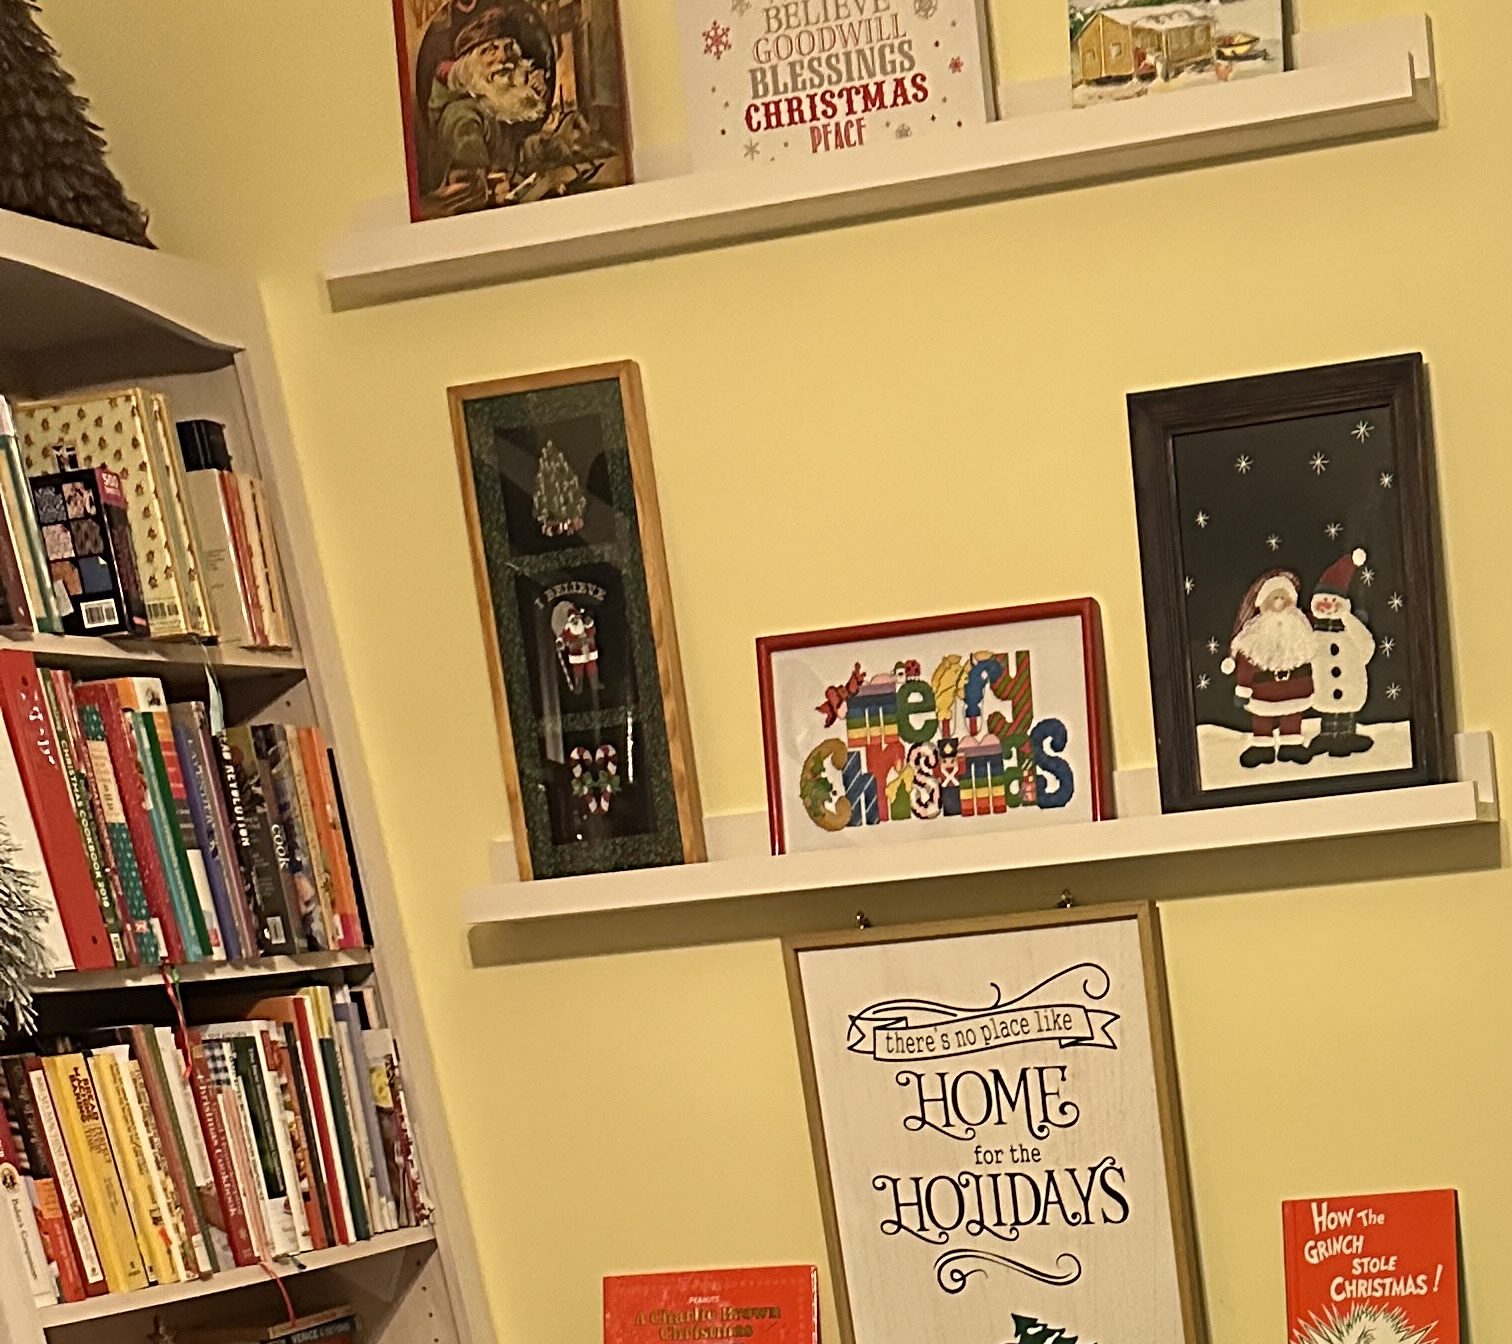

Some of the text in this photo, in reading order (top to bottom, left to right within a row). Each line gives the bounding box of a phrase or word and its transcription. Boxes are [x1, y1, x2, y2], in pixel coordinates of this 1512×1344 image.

[753, 13, 907, 64] GOODWILL
[764, 0, 890, 34] BELIEVE
[749, 39, 915, 100] BLESSINGS
[744, 73, 929, 132] CHRISTMAS
[534, 581, 607, 609] I BELIEVE
[59, 739, 83, 807] CHRISTMAS
[77, 809, 102, 878] COOKBOOK
[224, 763, 250, 847] REVOLUTION
[886, 1010, 1073, 1056] there's no place like
[896, 1066, 1079, 1140] HOME
[975, 1144, 1041, 1165] for the
[872, 1156, 1130, 1245] HOLIDAYS
[1357, 1209, 1385, 1227] The
[1304, 1235, 1364, 1264] GRINCH
[1352, 1256, 1397, 1275] STOLE
